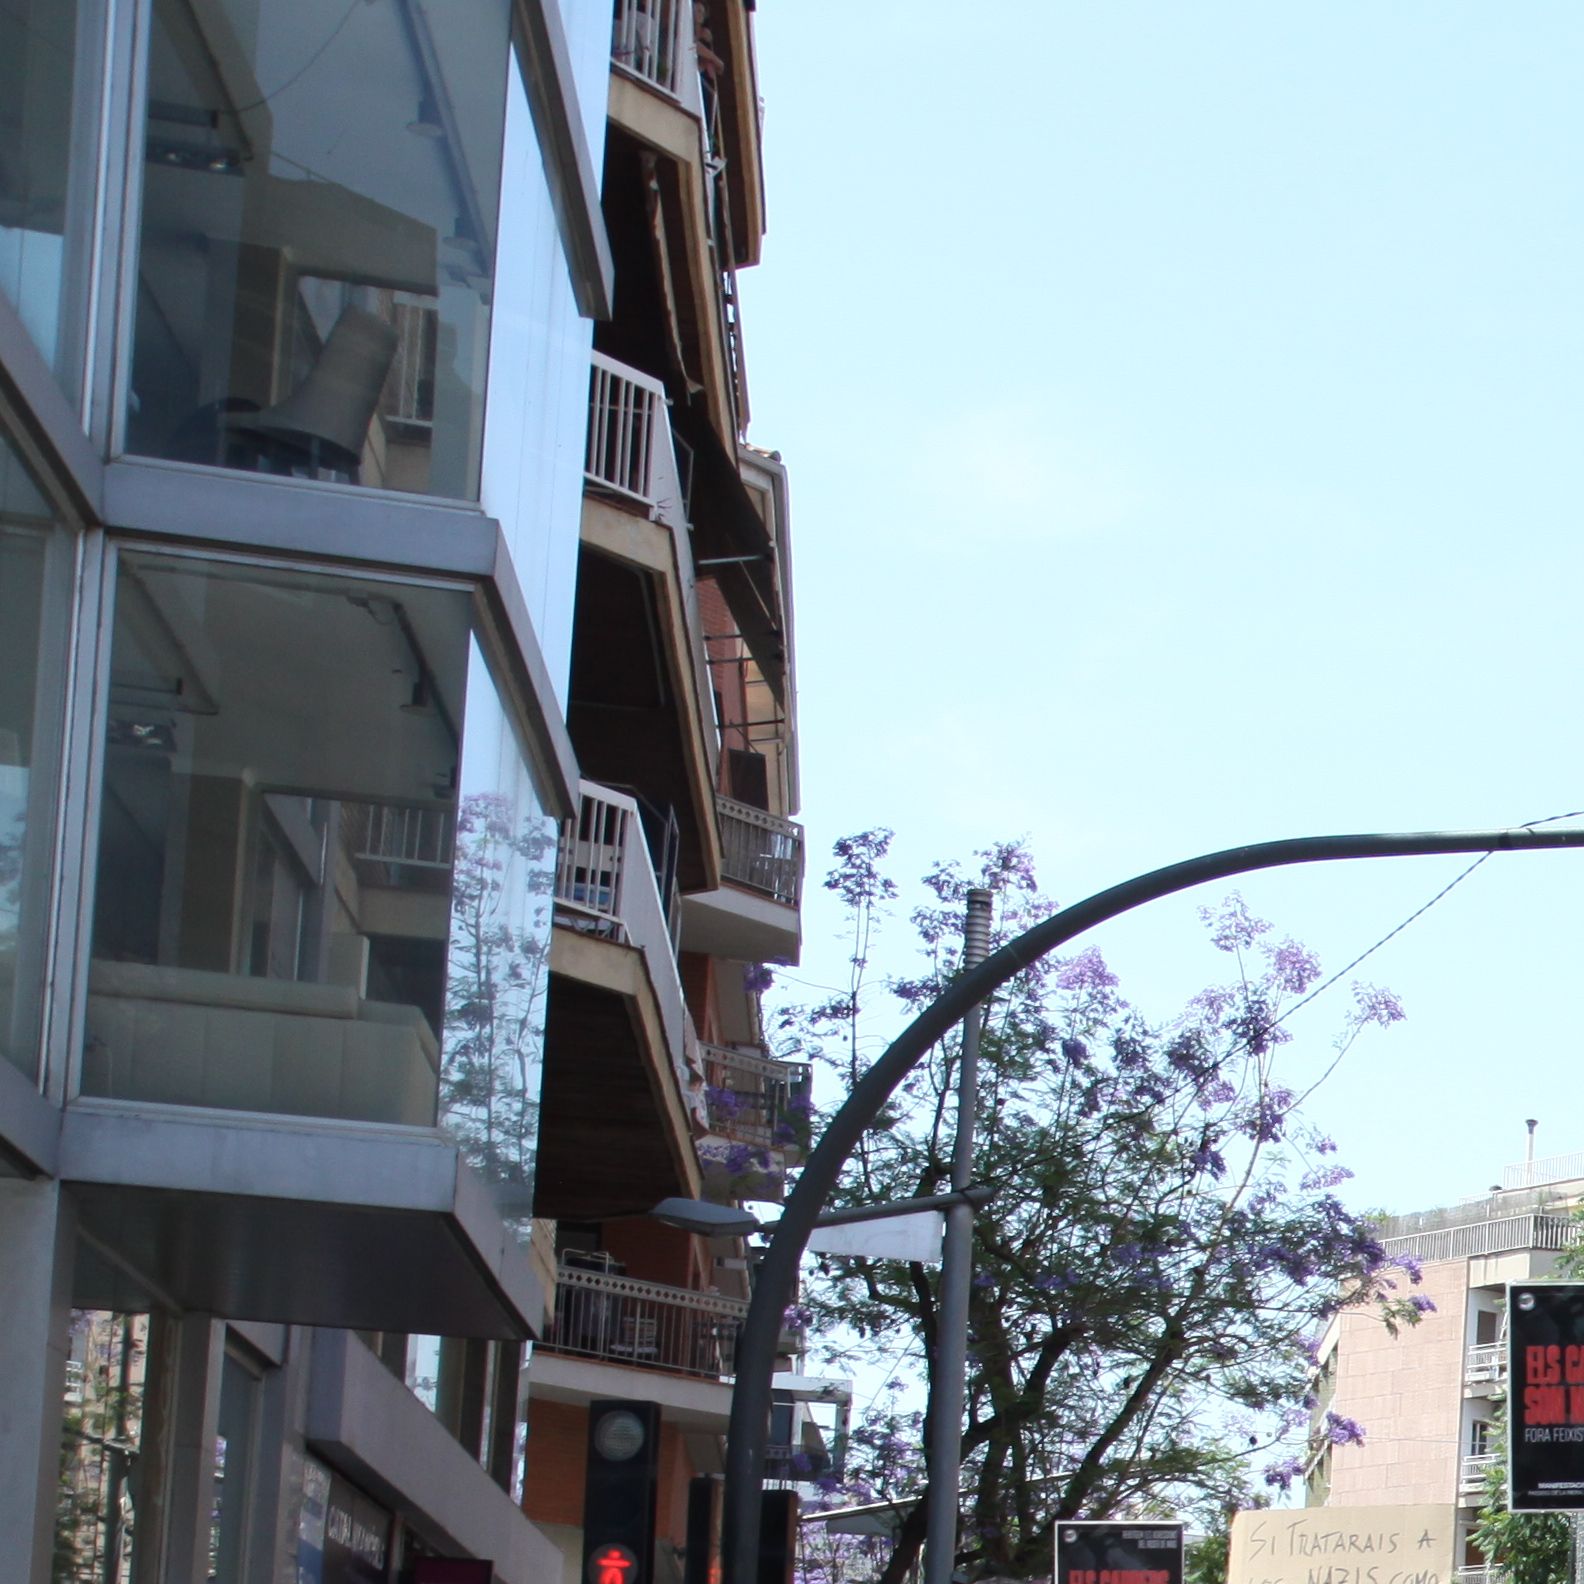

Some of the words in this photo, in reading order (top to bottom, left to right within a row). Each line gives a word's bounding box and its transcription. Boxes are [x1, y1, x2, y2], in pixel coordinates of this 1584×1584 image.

[1525, 1345, 1560, 1384] ELS
[1525, 1428, 1551, 1442] FORA
[1417, 1529, 1437, 1550] A
